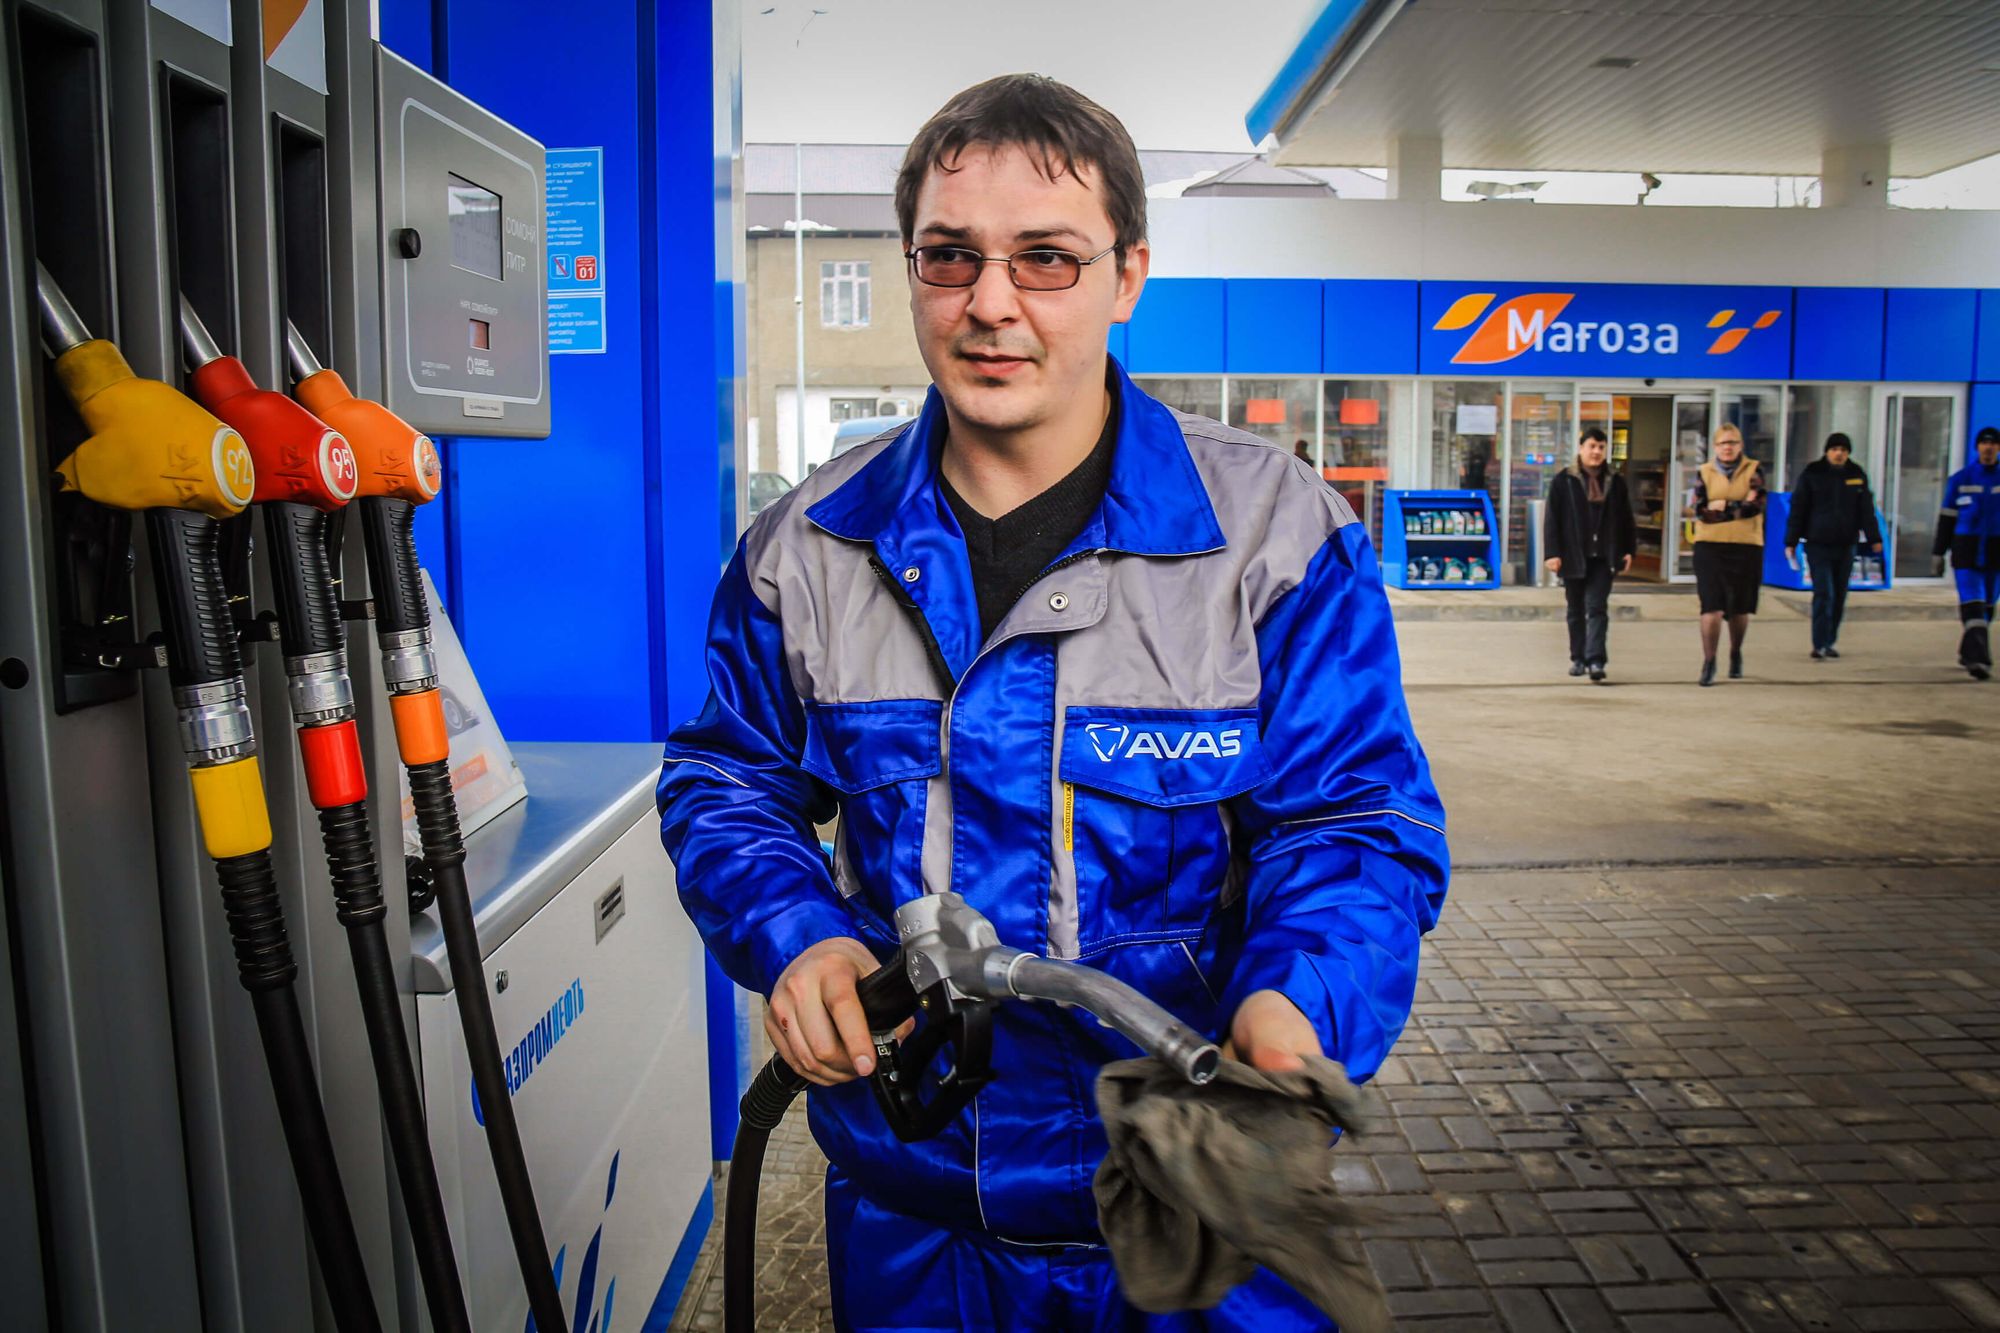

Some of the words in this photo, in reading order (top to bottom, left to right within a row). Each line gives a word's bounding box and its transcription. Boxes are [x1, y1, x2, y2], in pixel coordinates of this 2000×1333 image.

[579, 266, 593, 279] 01
[1507, 308, 1679, 355] Мағоза
[227, 448, 252, 485] 92
[332, 447, 354, 479] 95
[308, 662, 319, 670] FS
[201, 692, 214, 701] FS
[1125, 729, 1241, 759] AVAS
[502, 977, 584, 1097] АЗПРОМНЕФТЬ
